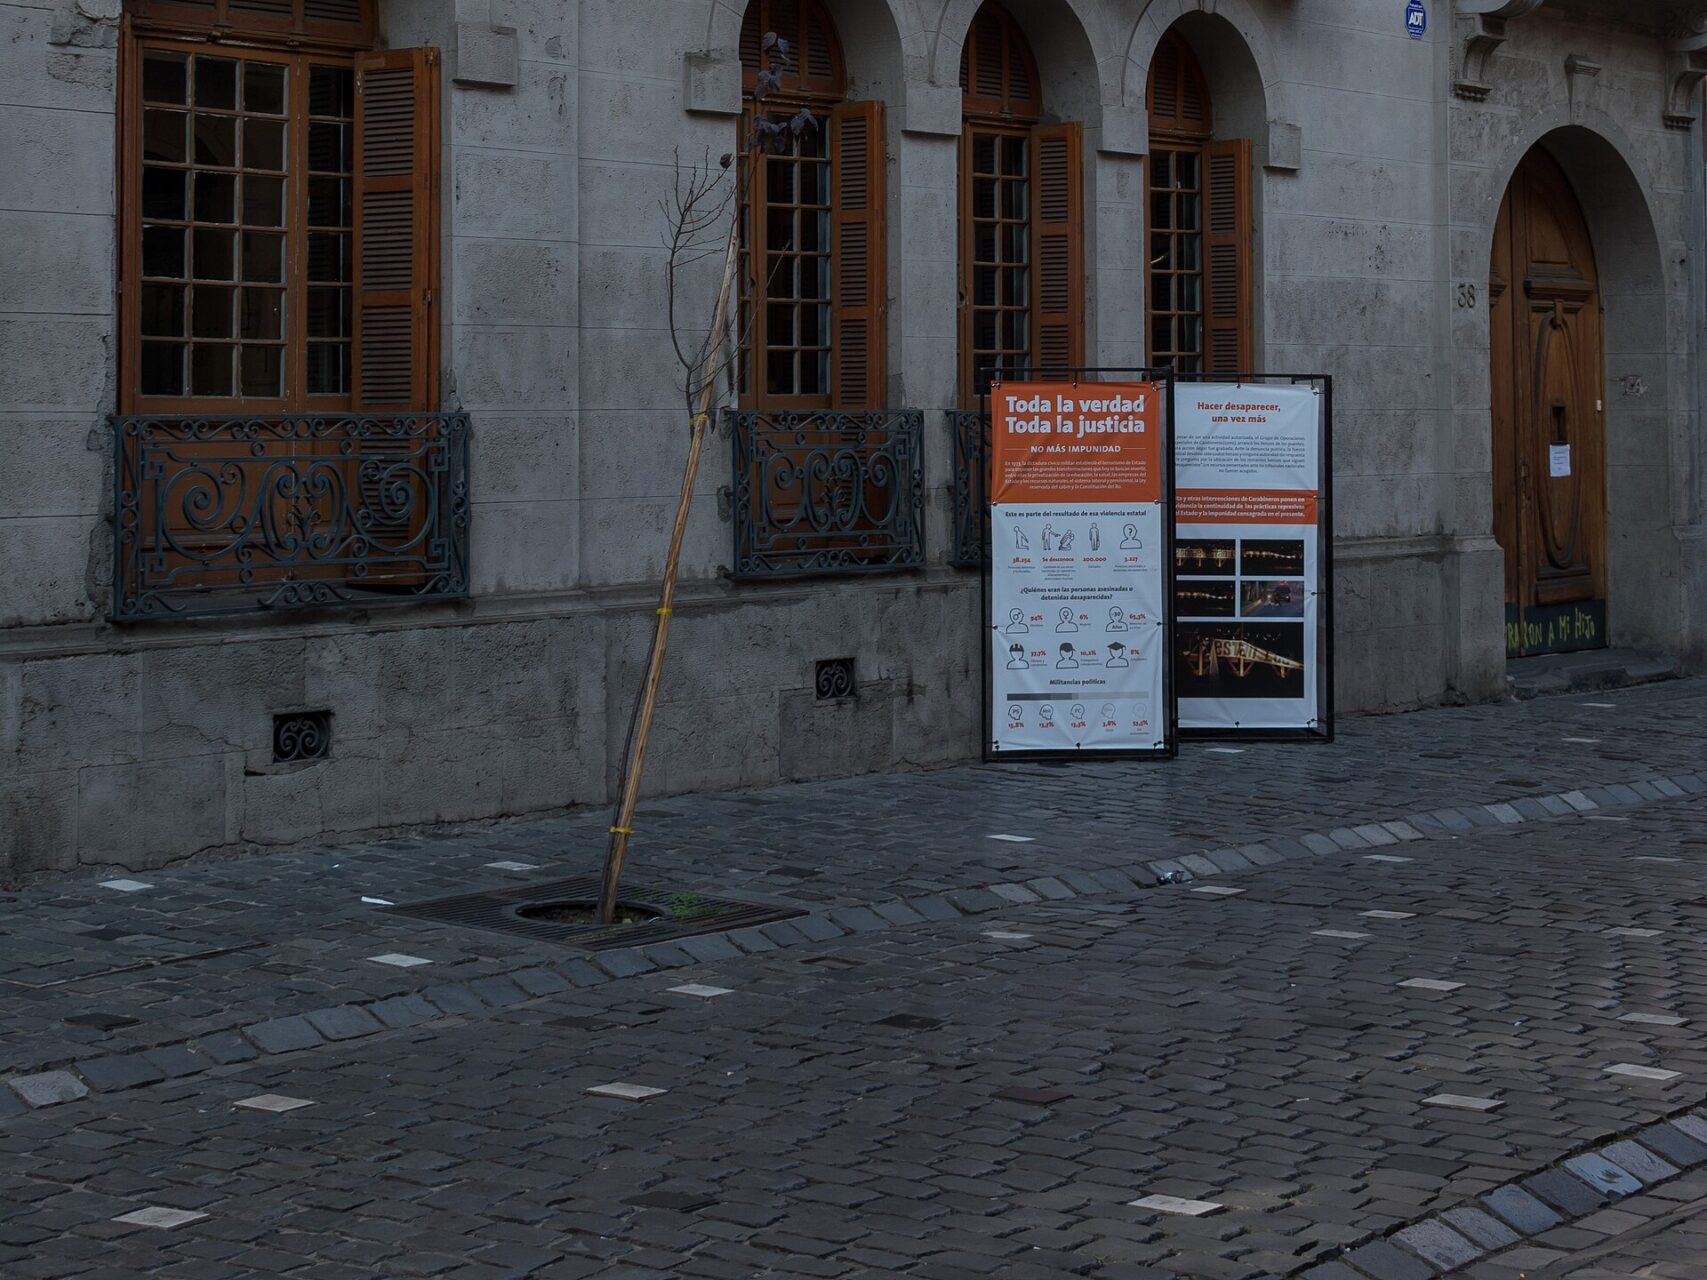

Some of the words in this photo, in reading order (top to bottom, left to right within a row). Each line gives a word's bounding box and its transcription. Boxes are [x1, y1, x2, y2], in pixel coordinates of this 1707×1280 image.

[1409, 12, 1424, 26] ADT
[1457, 282, 1476, 309] 38
[1005, 394, 1052, 413] Toda
[1057, 394, 1074, 413] la
[1078, 394, 1145, 413] verdad
[1197, 401, 1222, 411] Hacer
[1225, 402, 1281, 413] desaparecer,
[1211, 415, 1228, 423] una
[1231, 415, 1245, 423] vez
[1248, 414, 1266, 423] más
[1005, 415, 1052, 434] Toda
[1056, 415, 1074, 433] la
[1077, 415, 1145, 439] justicia
[1030, 445, 1045, 453] NO
[1046, 443, 1066, 453] MÁS
[1068, 445, 1121, 453] IMPUNIDAD
[1548, 620, 1555, 648] A
